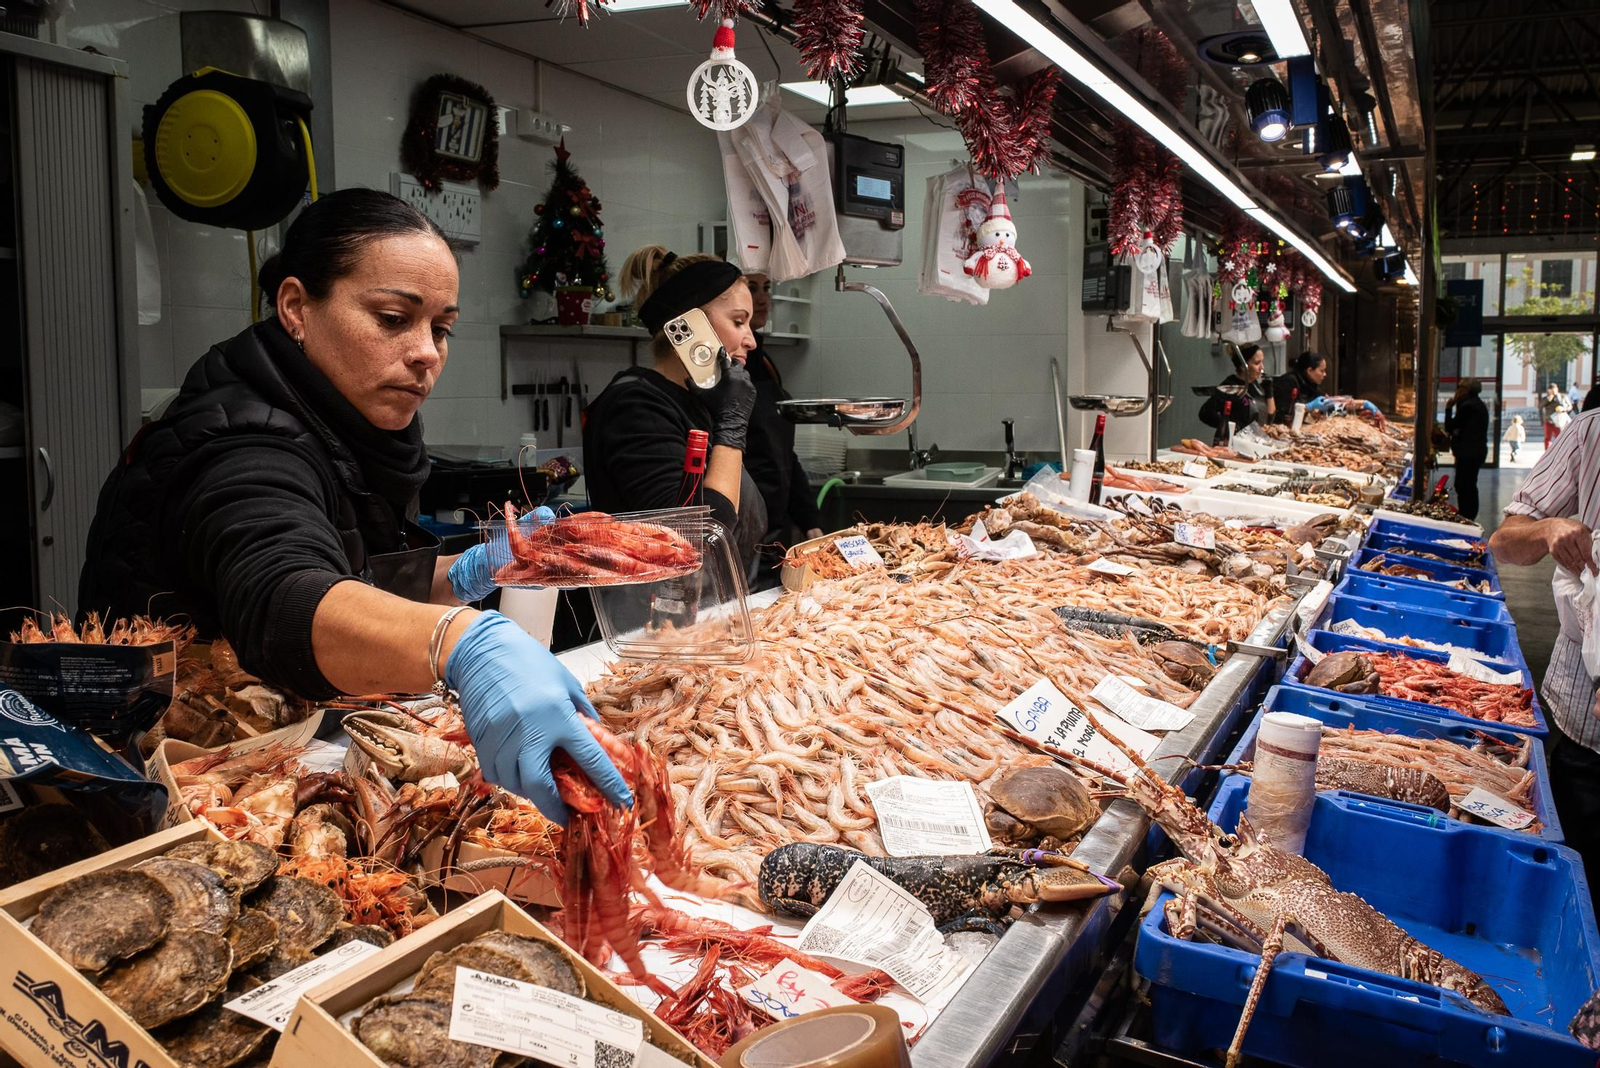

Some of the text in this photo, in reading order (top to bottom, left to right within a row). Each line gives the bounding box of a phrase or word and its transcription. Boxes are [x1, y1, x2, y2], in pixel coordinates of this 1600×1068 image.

[1015, 696, 1053, 732] GAMBA
[1062, 707, 1085, 735] PUNTA
[1077, 723, 1098, 748] MORA
